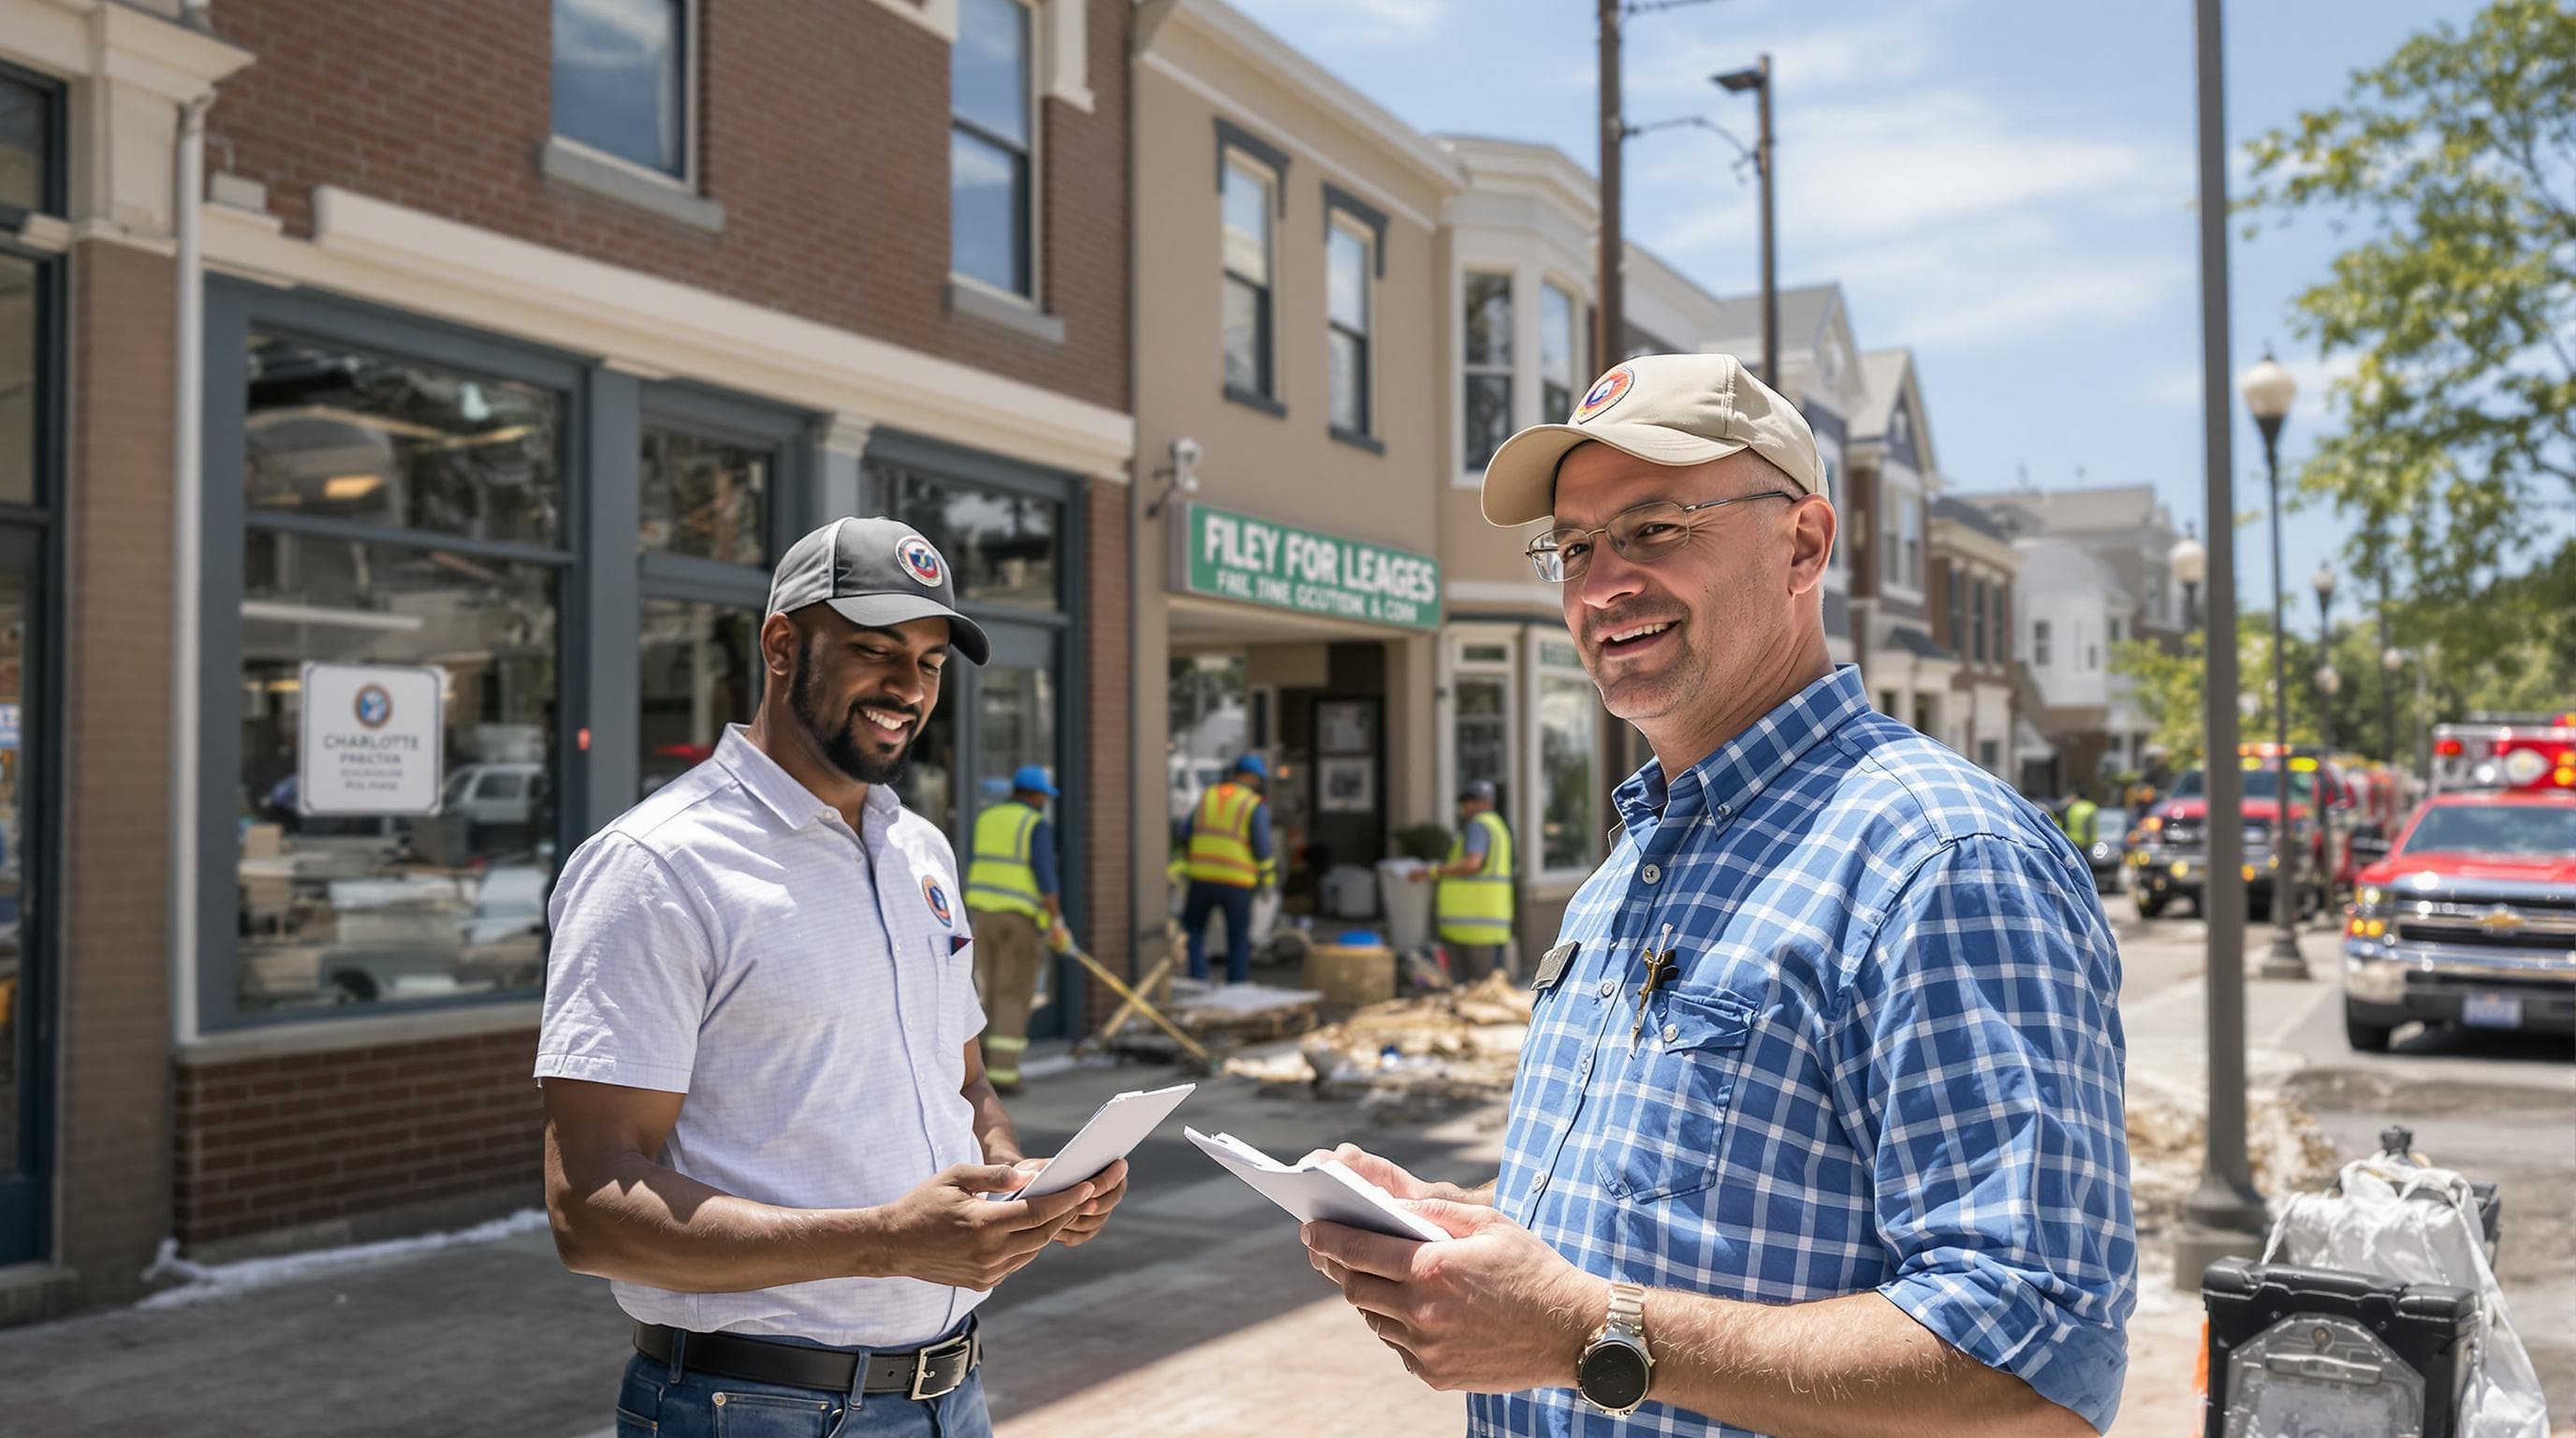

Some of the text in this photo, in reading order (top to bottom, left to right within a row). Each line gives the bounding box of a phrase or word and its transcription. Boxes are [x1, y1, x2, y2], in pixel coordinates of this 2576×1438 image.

[1205, 514, 1437, 605] FILEY FOR LEAGES
[323, 733, 419, 751] CHARLOTTE
